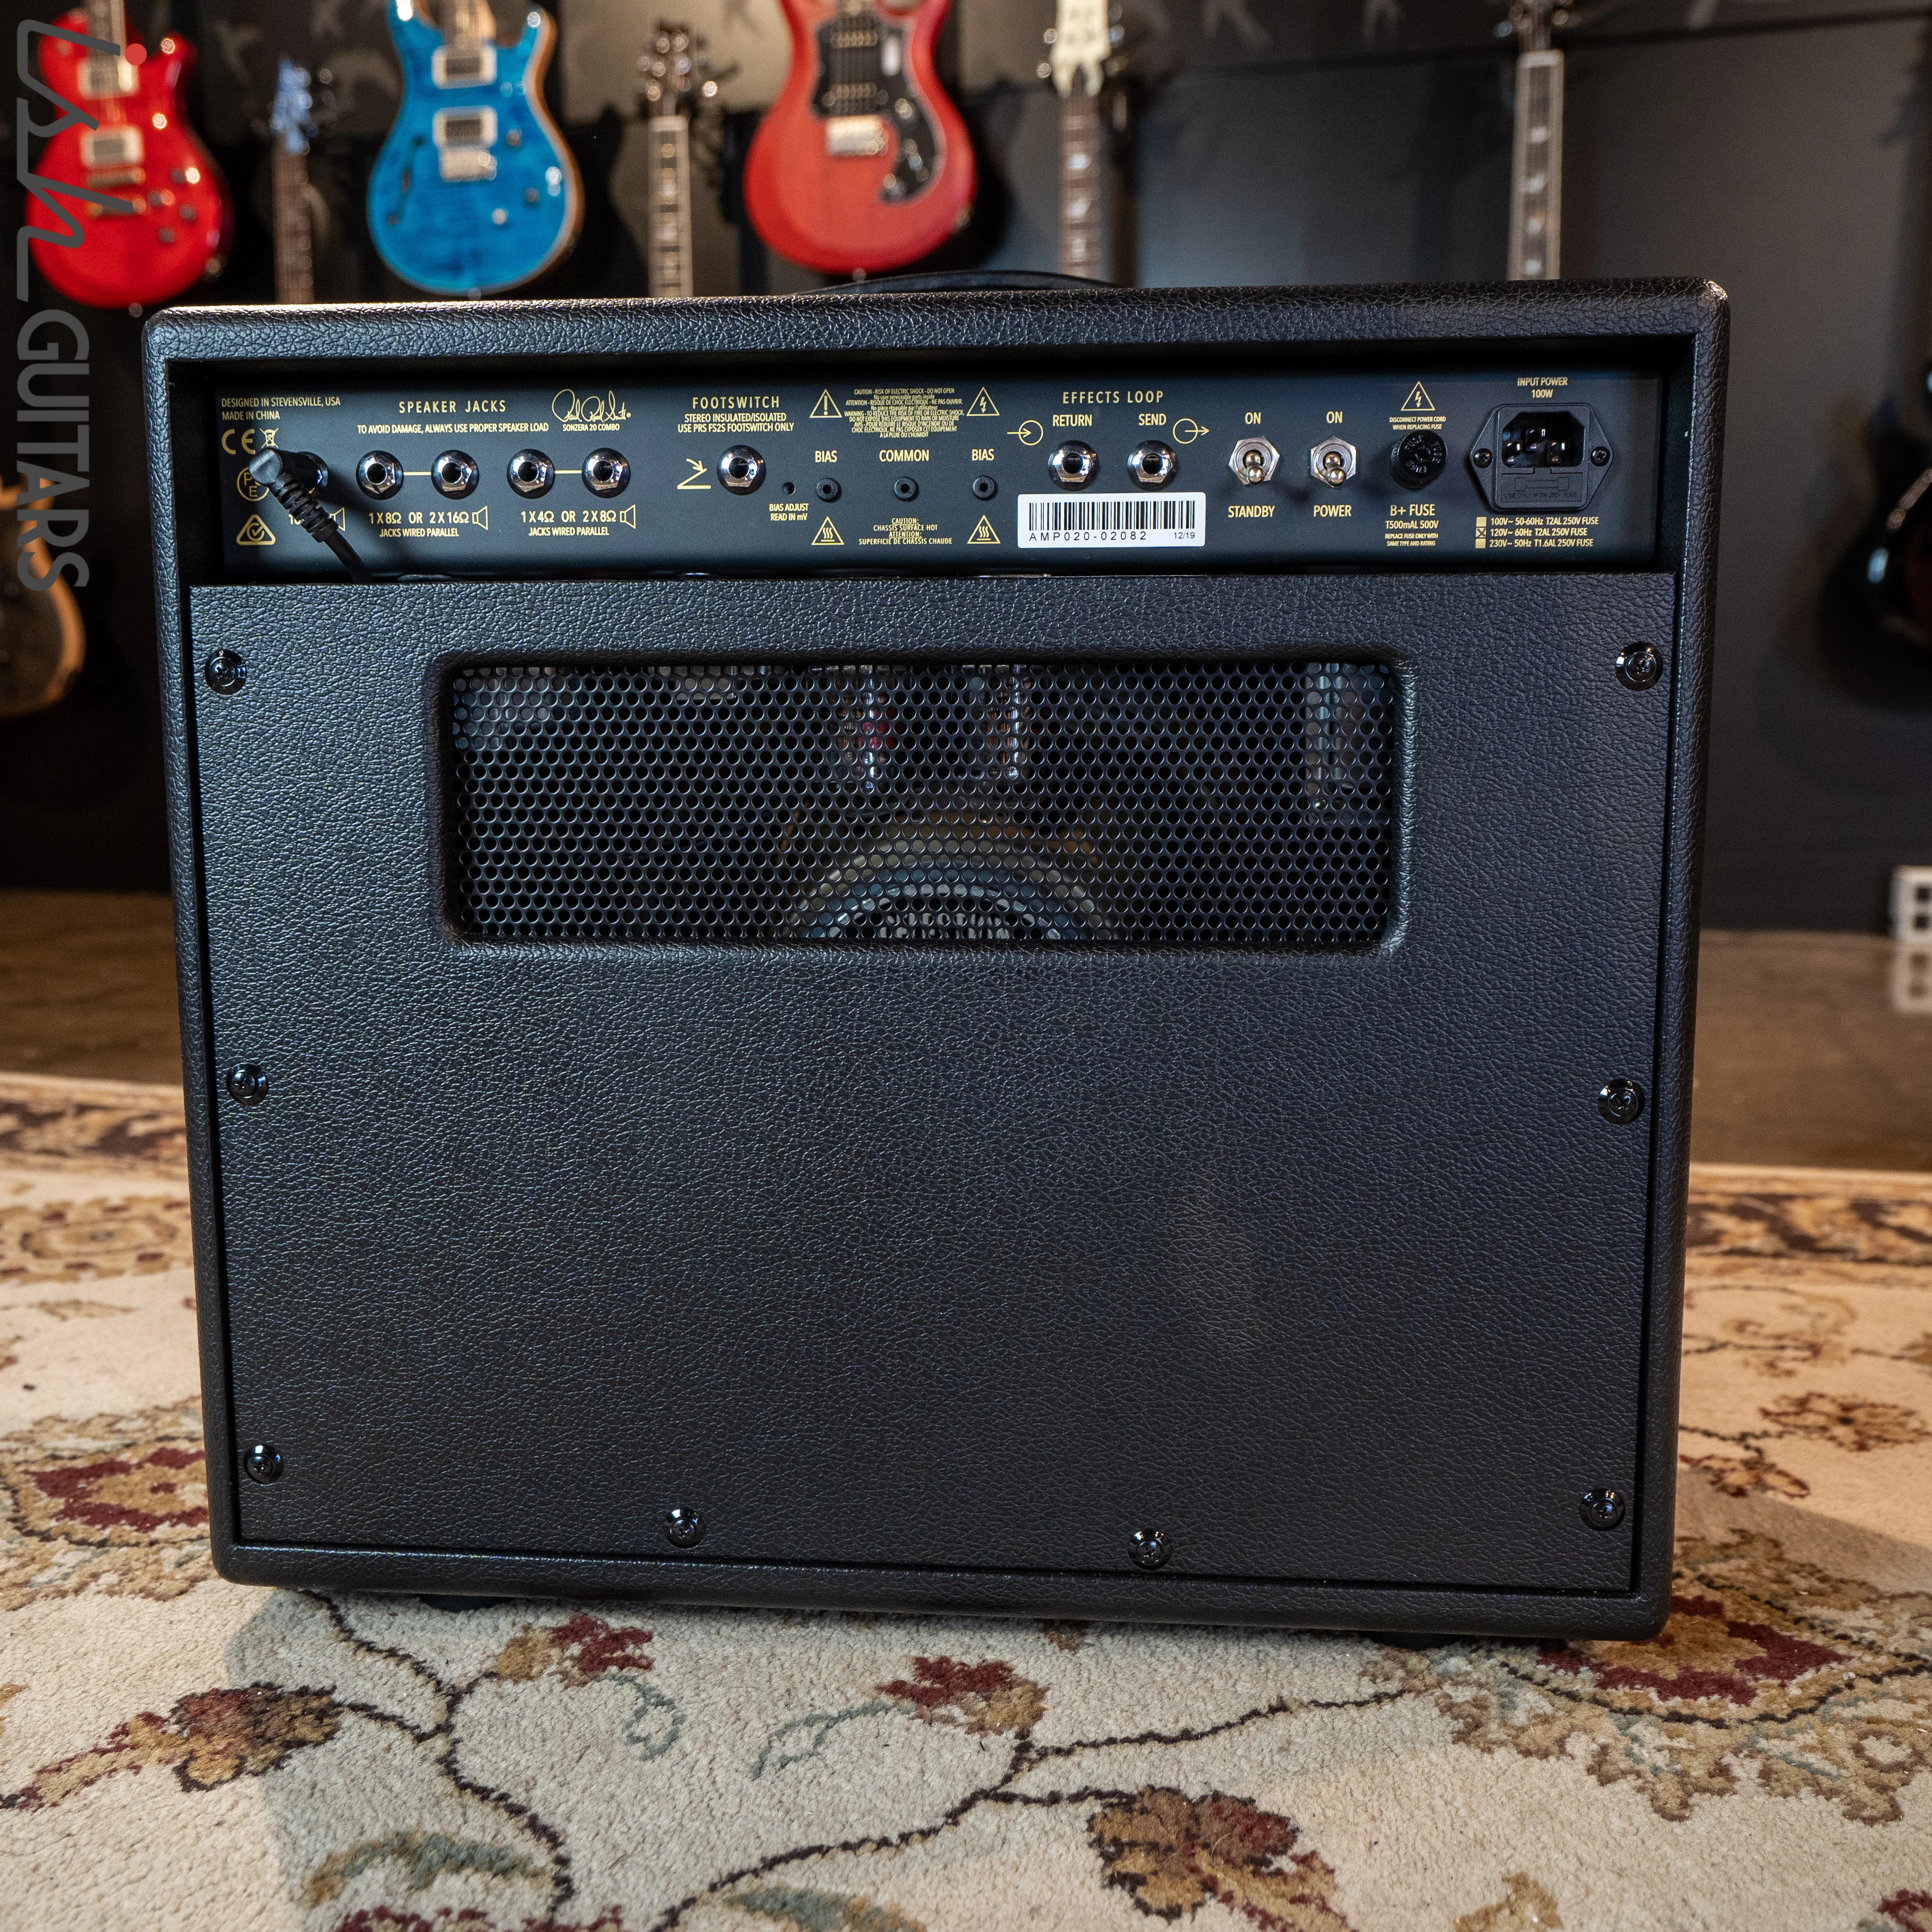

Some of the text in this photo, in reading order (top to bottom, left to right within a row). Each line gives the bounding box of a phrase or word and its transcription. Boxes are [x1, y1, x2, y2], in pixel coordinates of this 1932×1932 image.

[1517, 377, 1568, 386] INPUT POWER
[1063, 391, 1163, 403] EFFECTS LOOP
[1531, 389, 1553, 398] 100W
[221, 396, 340, 407] DESIGNED IN STEVENSVILLE, USA
[399, 400, 506, 413] SPEAKER JACKS
[693, 396, 779, 408] FOOTSWITCH
[222, 410, 280, 420] MADE IN CHINA
[684, 413, 786, 422] STEREO INSULATED/ISOLATED
[1053, 414, 1092, 426] RETURN
[1139, 413, 1166, 425] SEND
[1245, 412, 1261, 424] ON
[1327, 411, 1343, 423] ON
[357, 422, 549, 434] TO AVOID DAMAGE, ALWAYS USE PROPER SPEAKER LOAD
[563, 423, 588, 432] SONZERA
[589, 423, 597, 431] 20
[678, 424, 692, 433] USE
[693, 423, 707, 432] PRS
[727, 423, 773, 432] FOOTSWITCH
[775, 422, 794, 431] ONLY
[815, 450, 837, 463] BIAS
[879, 449, 930, 462] COMMON
[972, 449, 994, 461] BIAS
[1228, 505, 1275, 518] STANDBY
[1314, 505, 1352, 517] POWER
[1390, 504, 1435, 516] B+ FUSE
[369, 511, 469, 525] 1 X 8Ω OR 2 X 16Ω
[521, 510, 616, 523] 1 X 4Ω OR 2 X 8Ω
[529, 526, 609, 536] JACKS WIRED PARALLEL
[1385, 521, 1418, 529] T500mAL
[380, 528, 459, 538] JACKS WIRED PARALLEL
[1029, 531, 1147, 541] AMP020-02082
